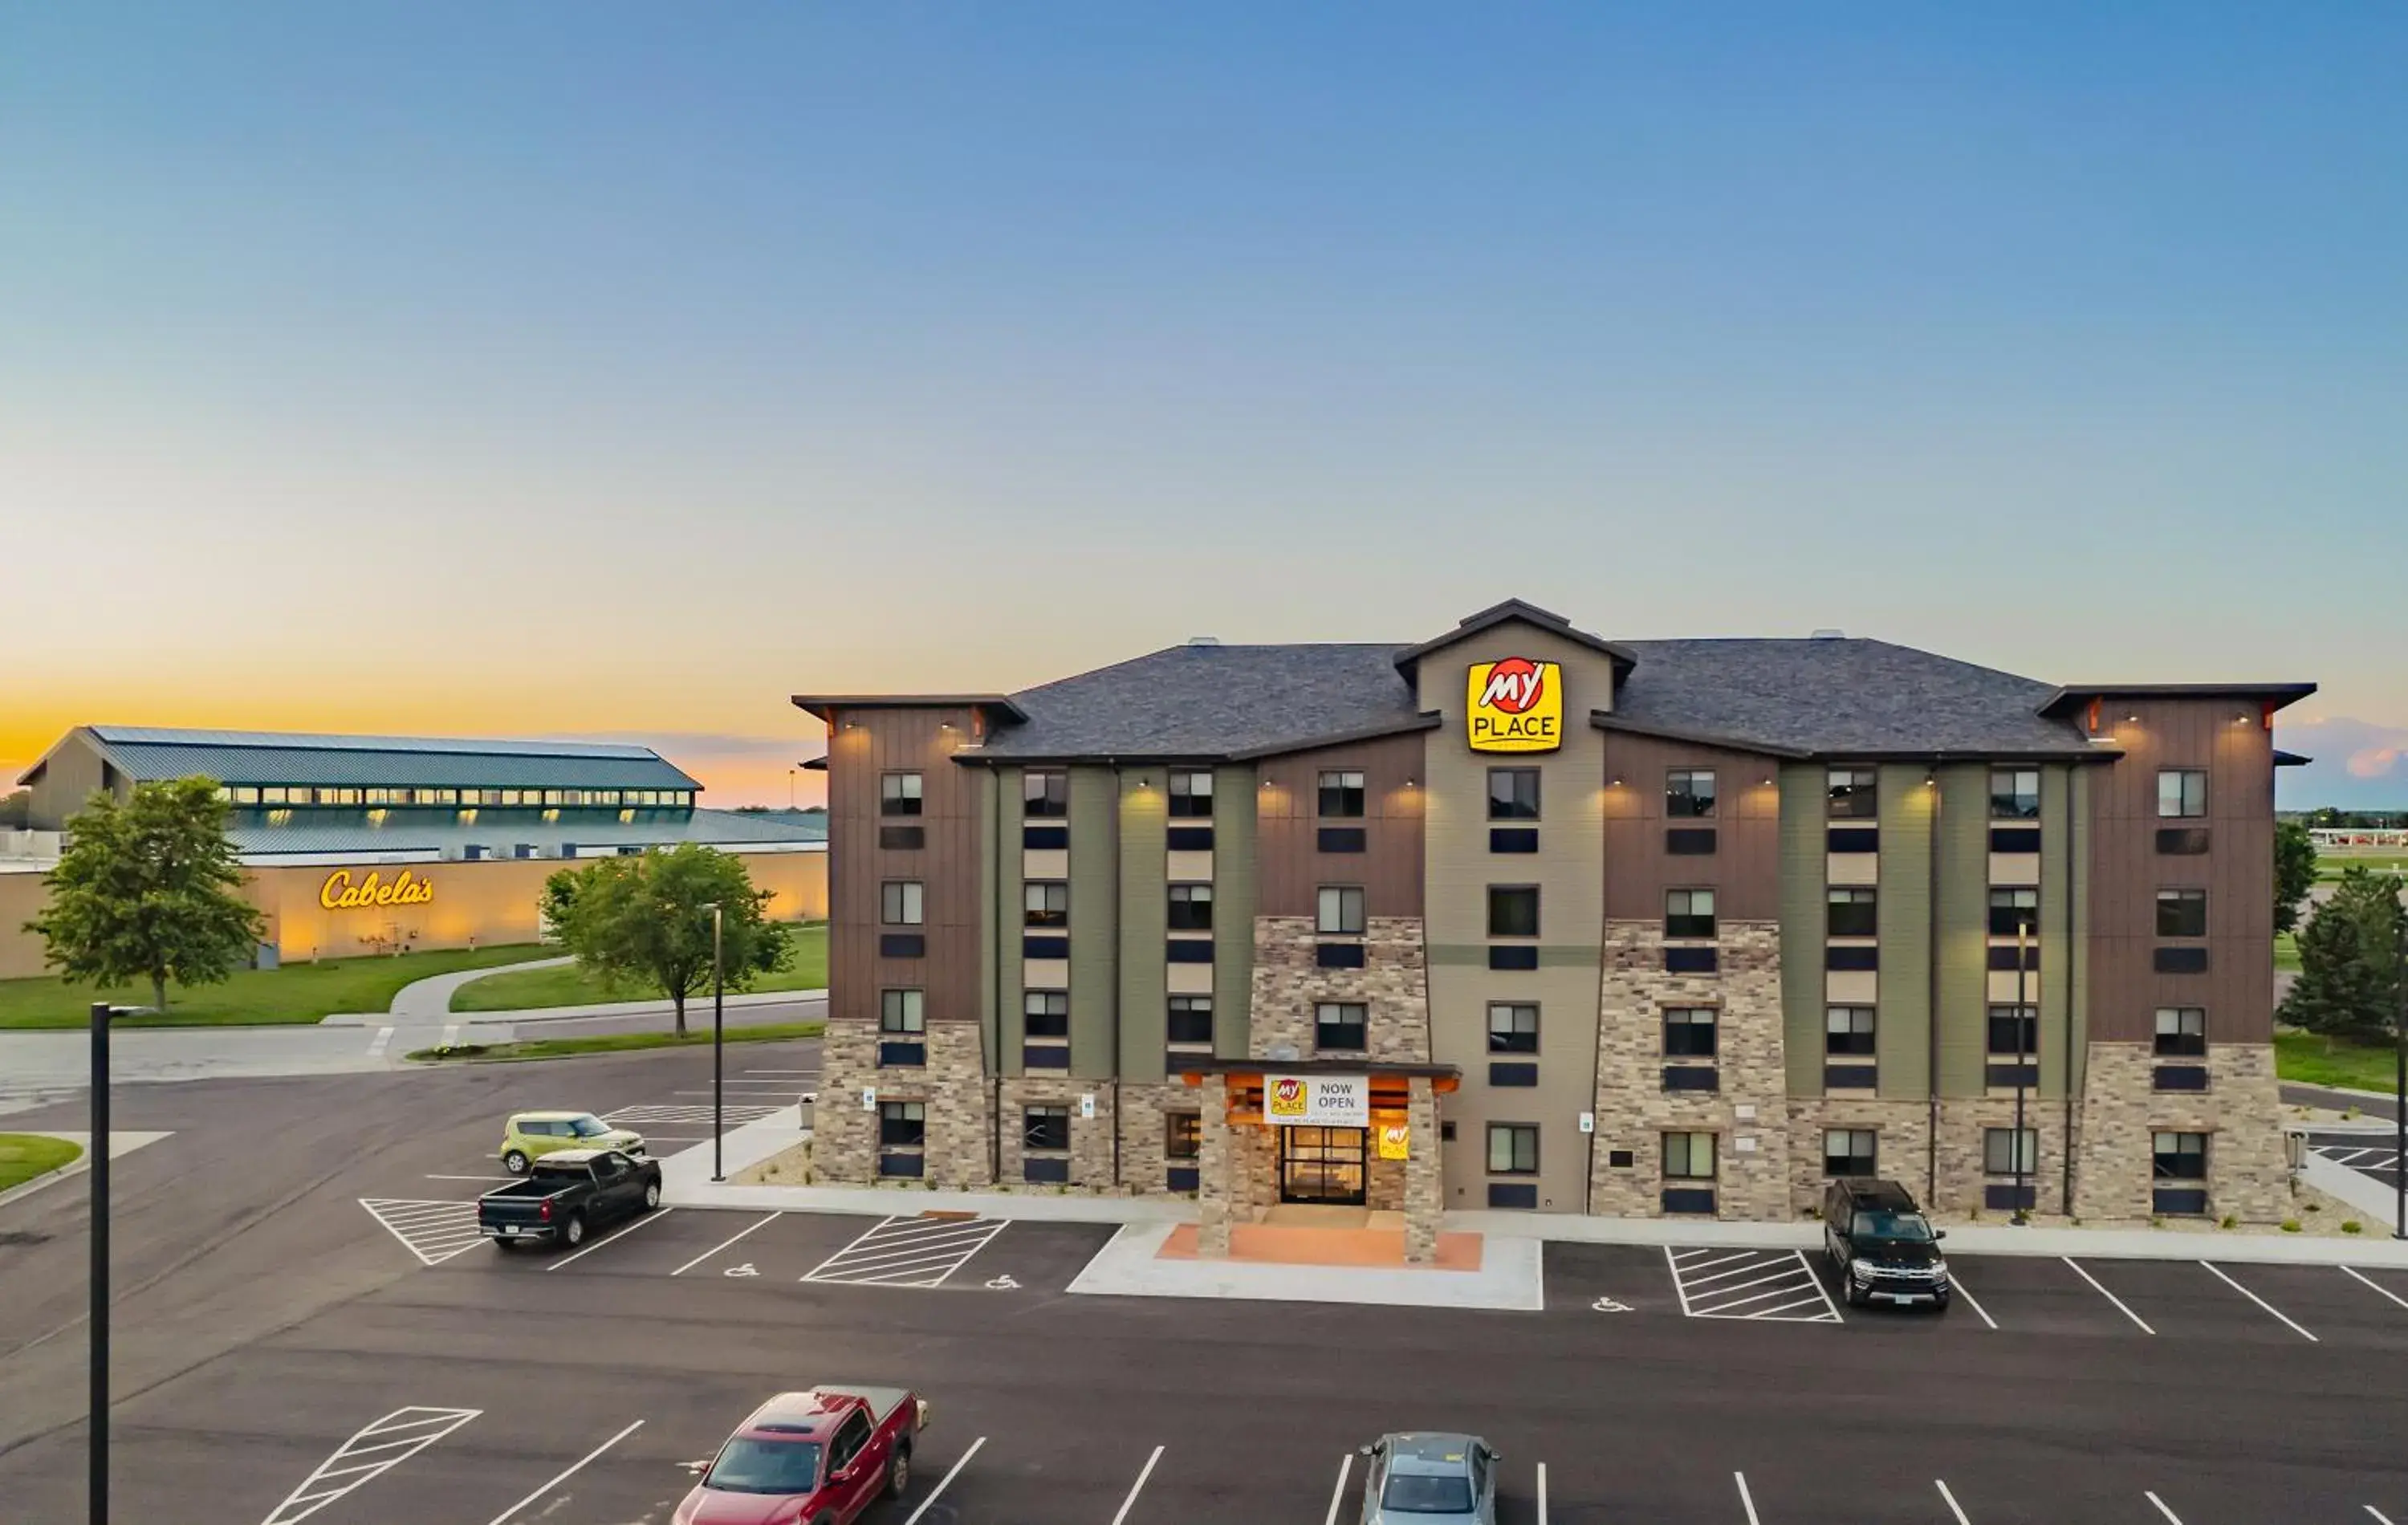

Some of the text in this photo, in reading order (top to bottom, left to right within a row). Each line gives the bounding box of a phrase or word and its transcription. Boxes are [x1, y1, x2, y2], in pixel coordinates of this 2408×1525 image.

[1474, 717, 1556, 736] PLACE
[320, 869, 433, 909] Cabela's
[1320, 1084, 1352, 1094] NOW
[1273, 1100, 1304, 1110] PLACE
[1319, 1097, 1355, 1108] OPEN
